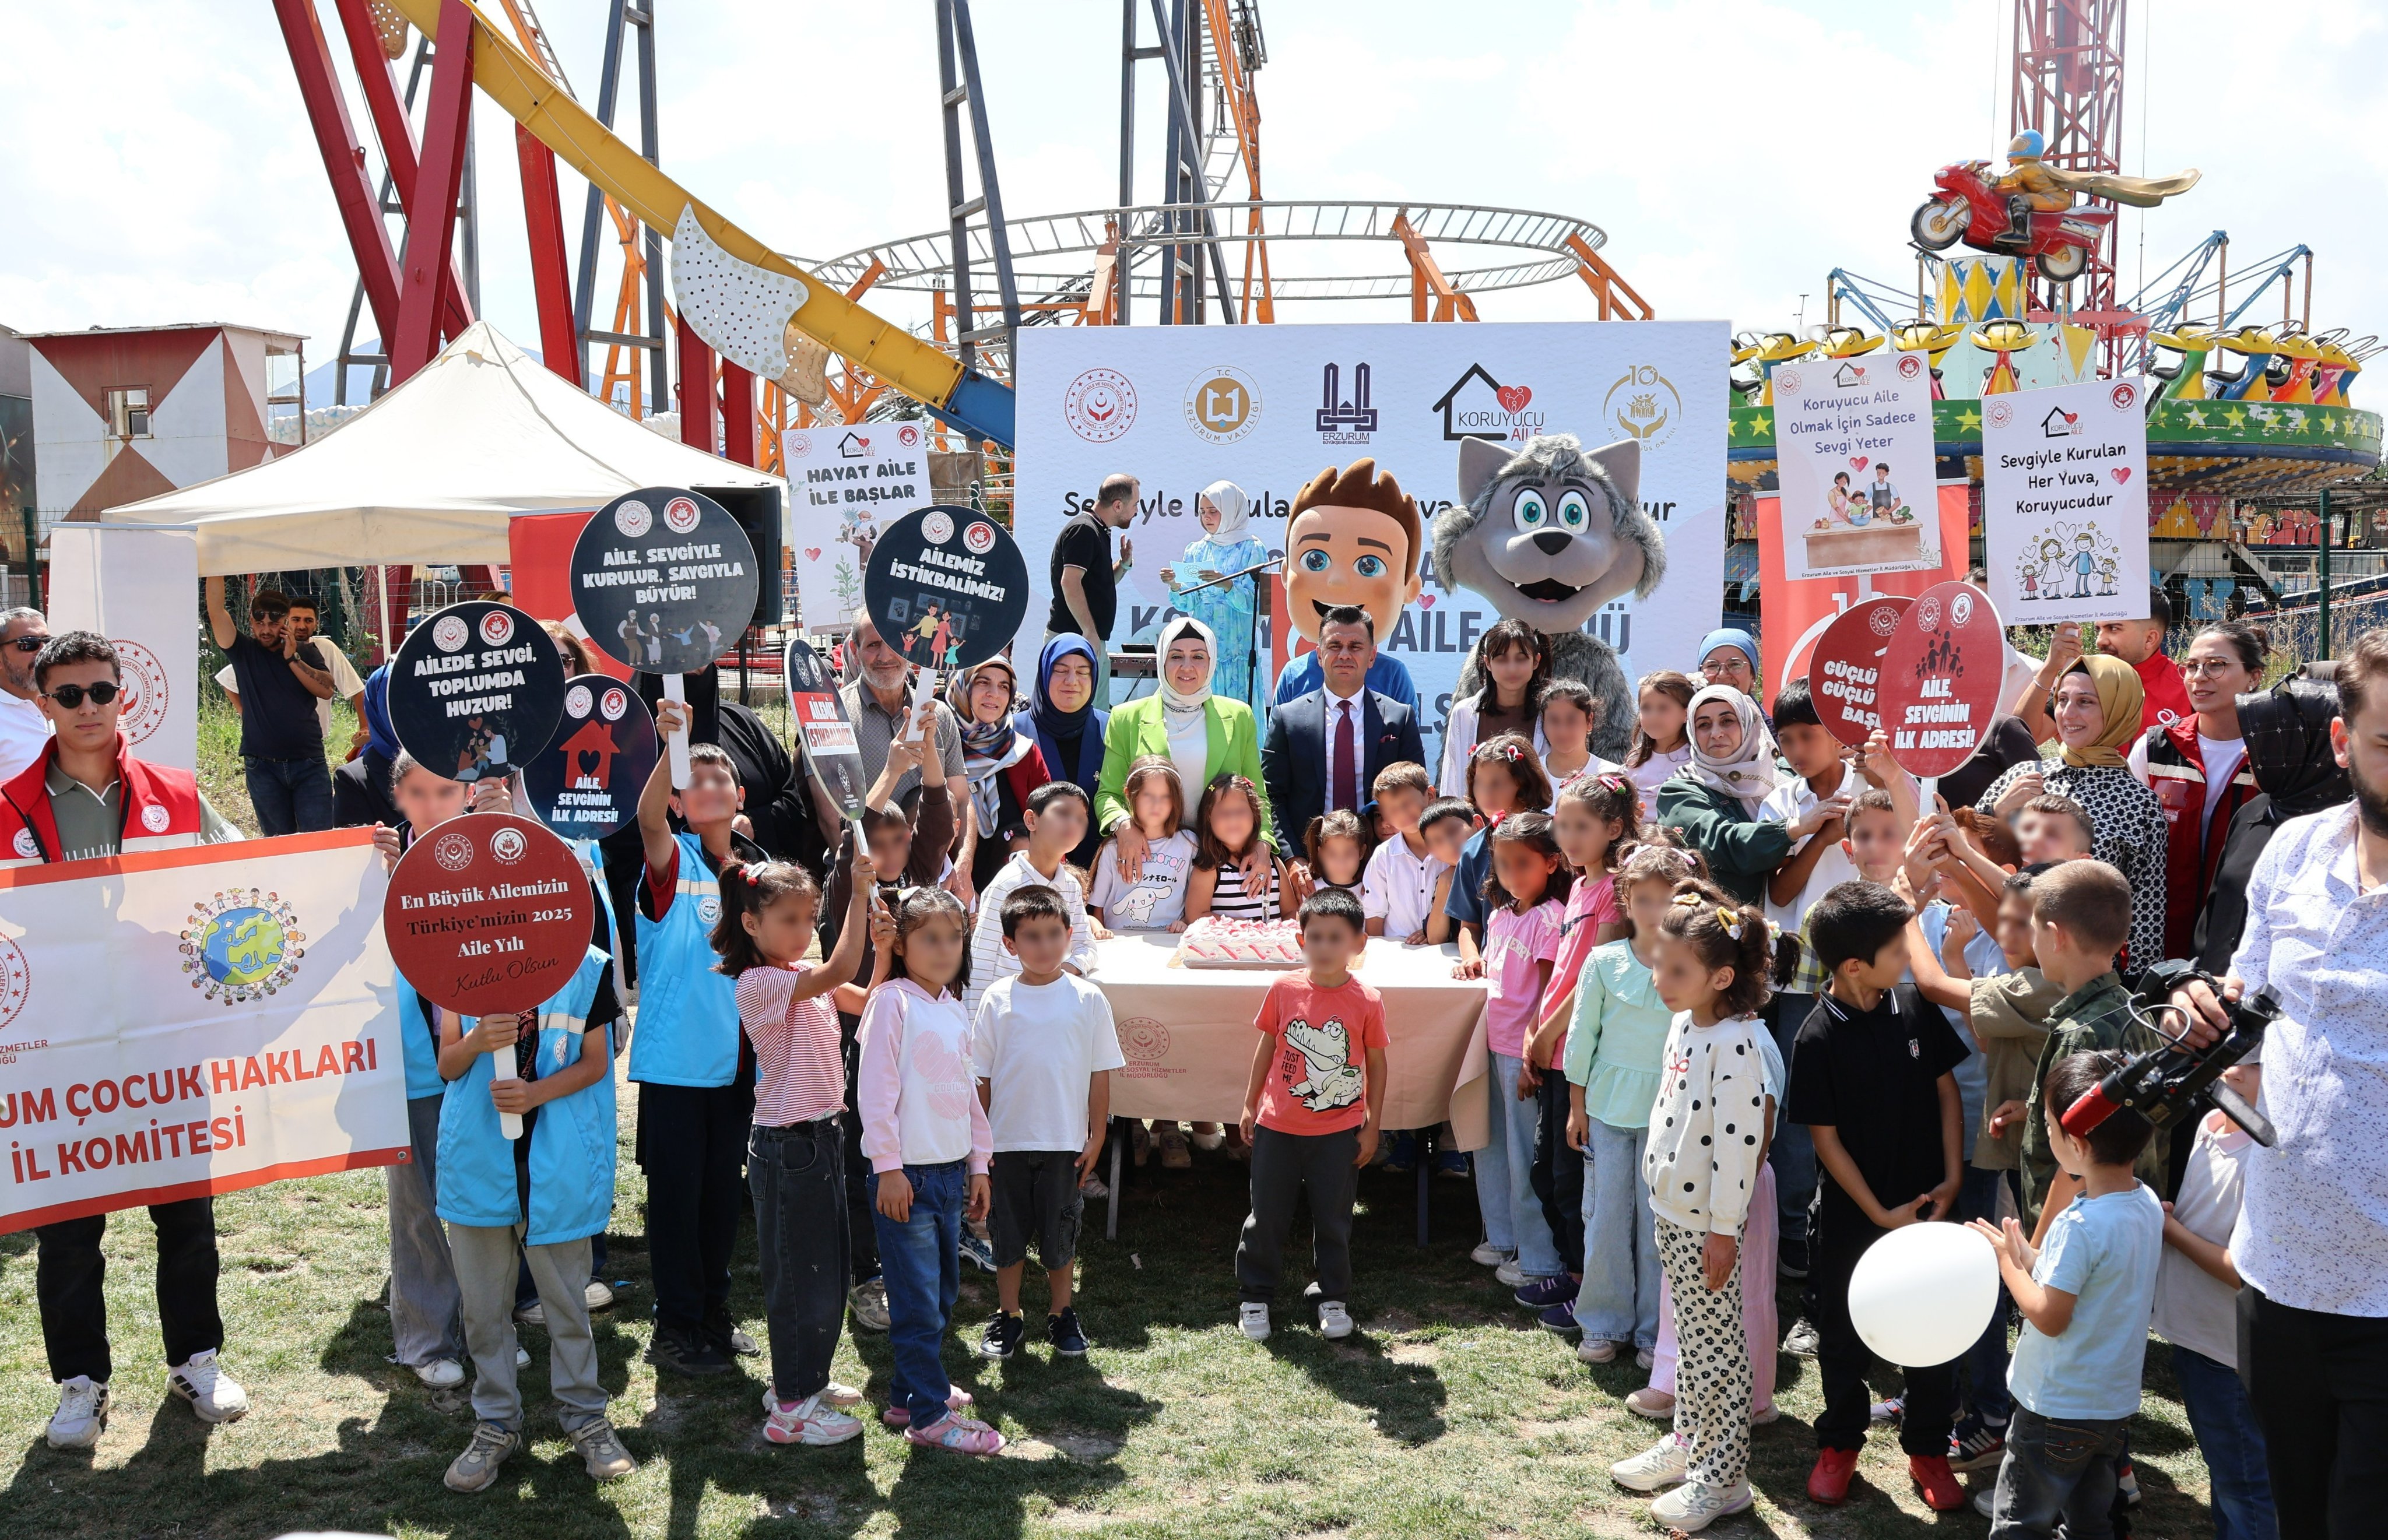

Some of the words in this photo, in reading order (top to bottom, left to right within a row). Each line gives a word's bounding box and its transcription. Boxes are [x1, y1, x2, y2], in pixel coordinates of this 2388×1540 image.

[1803, 395, 1869, 412] Koruyucu
[1873, 389, 1899, 404] Aile
[1186, 402, 1220, 442] ERZURUM
[1227, 401, 1259, 441] VALİLİĞİ
[1459, 412, 1544, 426] KORUYUCU
[1790, 418, 1832, 435] Olmak
[1837, 414, 1861, 434] İçin
[1866, 410, 1916, 427] Sadece
[1323, 432, 1369, 441] ERZURUM
[1815, 437, 1852, 455] Sevgi
[1855, 436, 1894, 450] Yeter
[2001, 451, 2062, 470] Sevgiyle
[2067, 444, 2126, 462] Kurulan
[807, 465, 869, 484] HAYAT
[876, 458, 916, 476] AİLE
[2028, 474, 2053, 489] Her
[2059, 472, 2099, 487] Yuva,
[809, 488, 838, 506] İLE
[844, 484, 915, 505] BAŞLAR
[2016, 493, 2113, 515] Koruyucudur
[1063, 490, 1183, 525] Seyle
[603, 547, 641, 567] AİLE,
[647, 542, 722, 564] SEVGİYLE
[919, 547, 986, 576] AİLEMİZ
[583, 571, 663, 589] KURULUR,
[668, 562, 744, 582] SAYGIYLA
[889, 558, 1006, 603] İSTİKBALİMİZ!
[635, 583, 697, 604] BÜYÜR!
[121, 660, 141, 673] SOSYAL
[414, 654, 476, 677] AİLEDE
[482, 642, 537, 668] SEVGİ,
[429, 670, 526, 697] TOPLUMDA
[1824, 660, 1878, 685] GÜÇLÜ
[140, 670, 150, 704] HİZMETLER
[1822, 681, 1876, 705] GÜÇLÜ
[1920, 674, 1952, 698] AİLE,
[124, 704, 149, 727] BAKANLIĞI
[445, 693, 512, 718] HUZUR!
[1905, 699, 1970, 724] SEVGİNİN
[1894, 726, 1916, 749] İLK
[1919, 725, 1976, 748] ADRESİ!
[574, 774, 601, 790] AİLE,
[558, 790, 612, 807] SEVGİNİN
[552, 806, 570, 822] İLK
[574, 807, 619, 823] ADRESİ!
[493, 855, 503, 864] 2025
[518, 852, 526, 861] YILI
[1143, 874, 1177, 883] シナモロール
[400, 895, 424, 909] En
[428, 887, 485, 908] Büyük
[487, 878, 569, 901] Ailemizin
[532, 908, 573, 922] 2025
[458, 940, 491, 957] Aile
[494, 936, 525, 951] Yılı
[451, 967, 504, 997] Kutlu
[507, 957, 559, 978] Olsun
[1281, 1061, 1297, 1074] FEED
[1283, 1050, 1300, 1063] JUST
[65, 1064, 204, 1127] ÇOCUK
[210, 1038, 378, 1095] HAKLARI
[1283, 1074, 1293, 1084] ME
[11, 1140, 51, 1184] İL
[57, 1105, 247, 1176] KOMİTESİ
